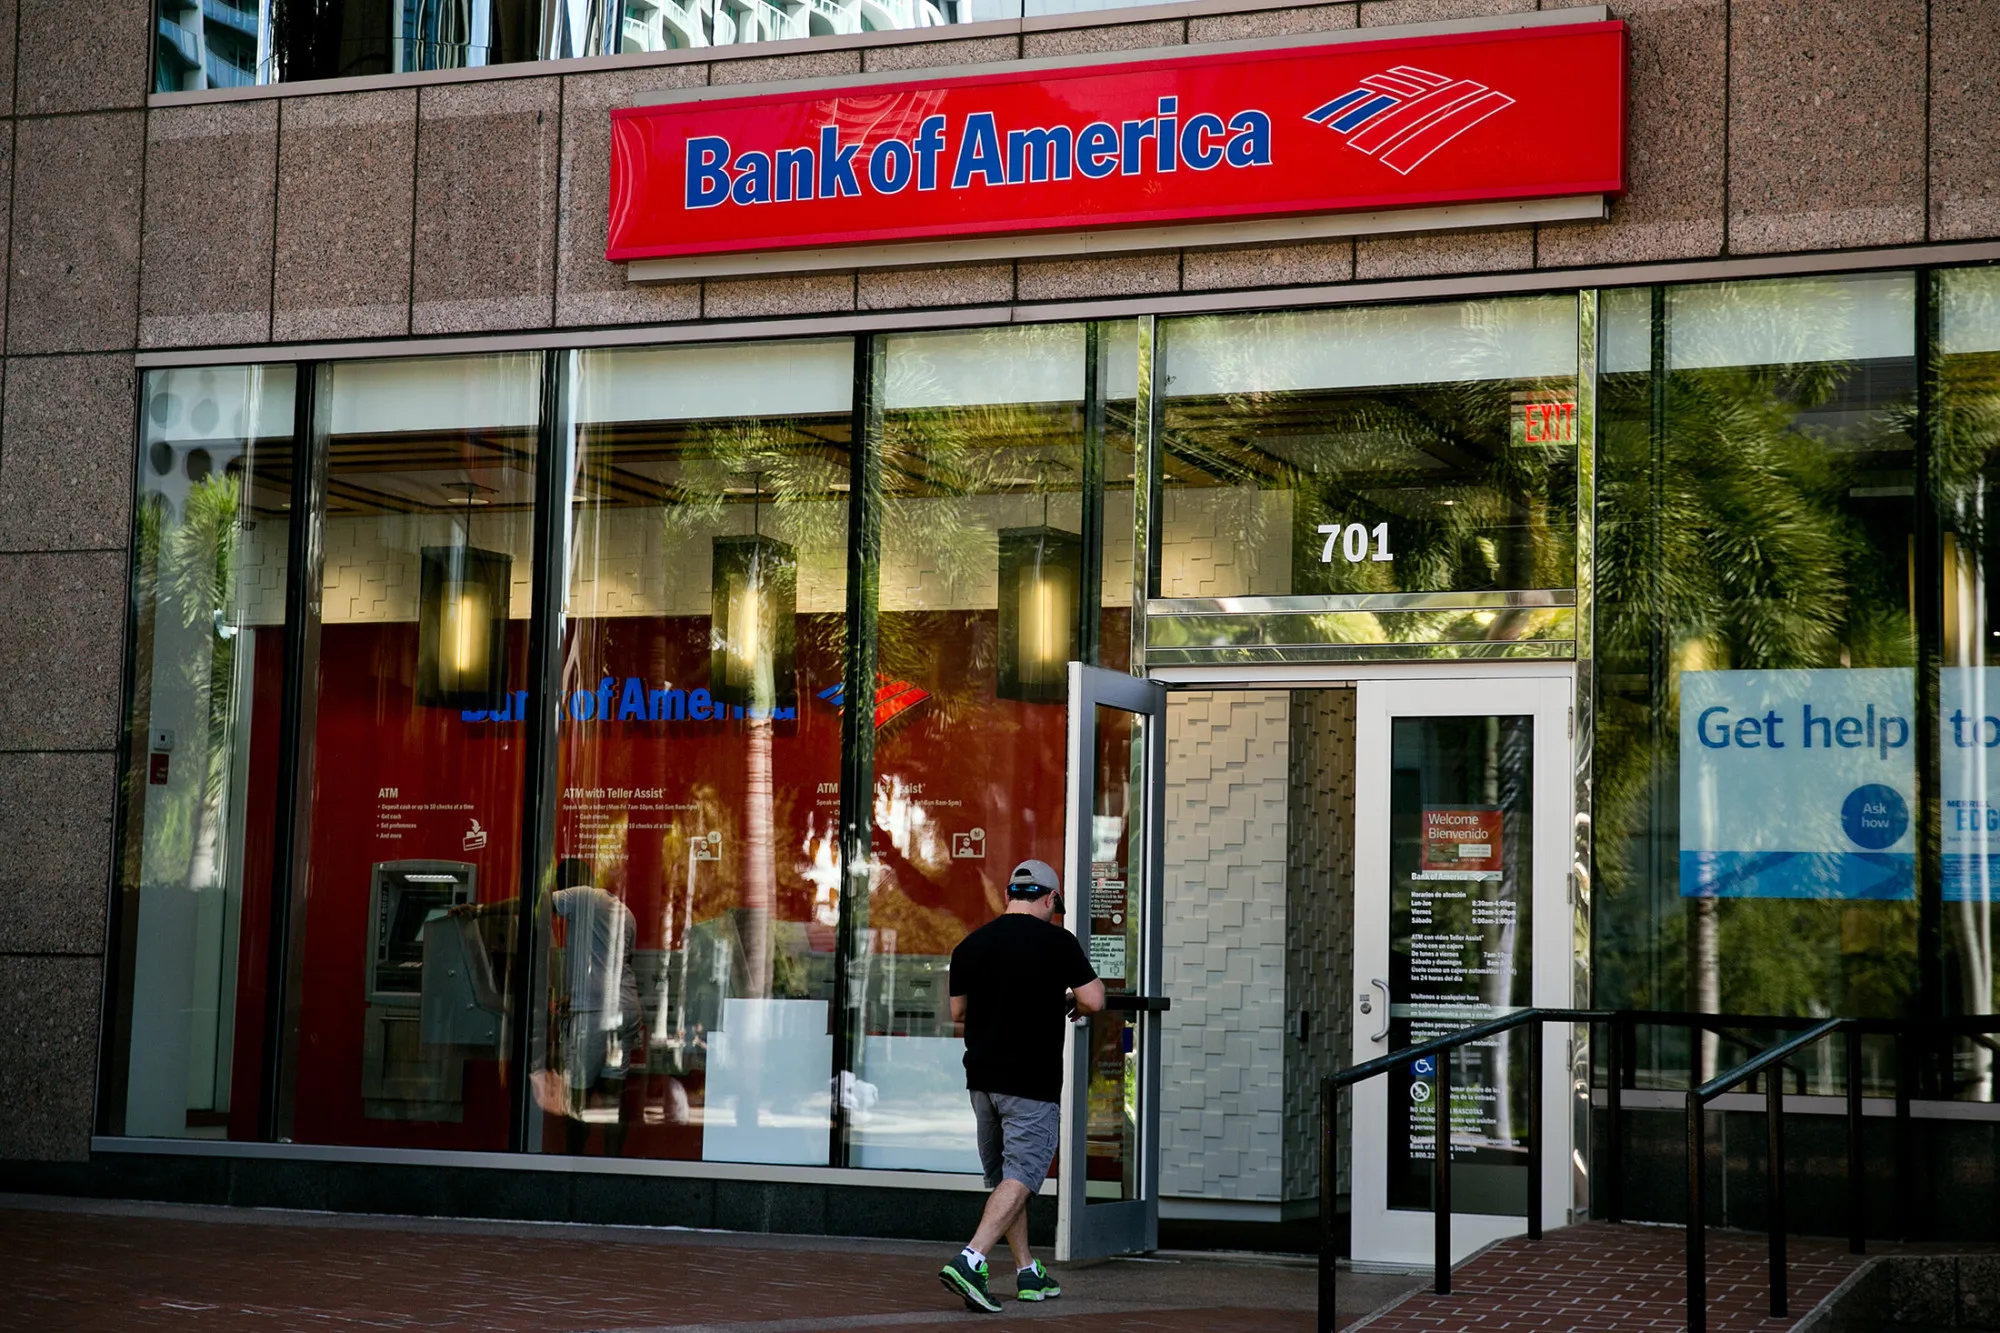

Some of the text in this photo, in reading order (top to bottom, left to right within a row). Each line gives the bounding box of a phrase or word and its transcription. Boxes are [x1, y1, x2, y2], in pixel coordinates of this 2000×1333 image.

[685, 96, 1273, 210] Bank of America
[1525, 402, 1576, 442] EXIT
[1318, 522, 1394, 562] 701
[570, 677, 615, 722] of
[1697, 704, 2000, 760] Get help to
[378, 787, 399, 798] ATM
[563, 788, 584, 799] ATM
[585, 788, 606, 799] with
[607, 788, 633, 799] Teller
[816, 783, 839, 795] ATM
[1862, 802, 1887, 815] Ask
[1947, 800, 1990, 808] MERRIL
[1428, 813, 1479, 825] Welcome
[1861, 817, 1889, 829] how
[1956, 809, 2000, 832] EDG
[1428, 827, 1489, 840] Bienvenido
[1411, 872, 1429, 880] Bank
[1437, 872, 1468, 880] America
[1447, 944, 1464, 952] cajero
[1436, 959, 1463, 967] domingos
[1440, 994, 1466, 1002] cualquier
